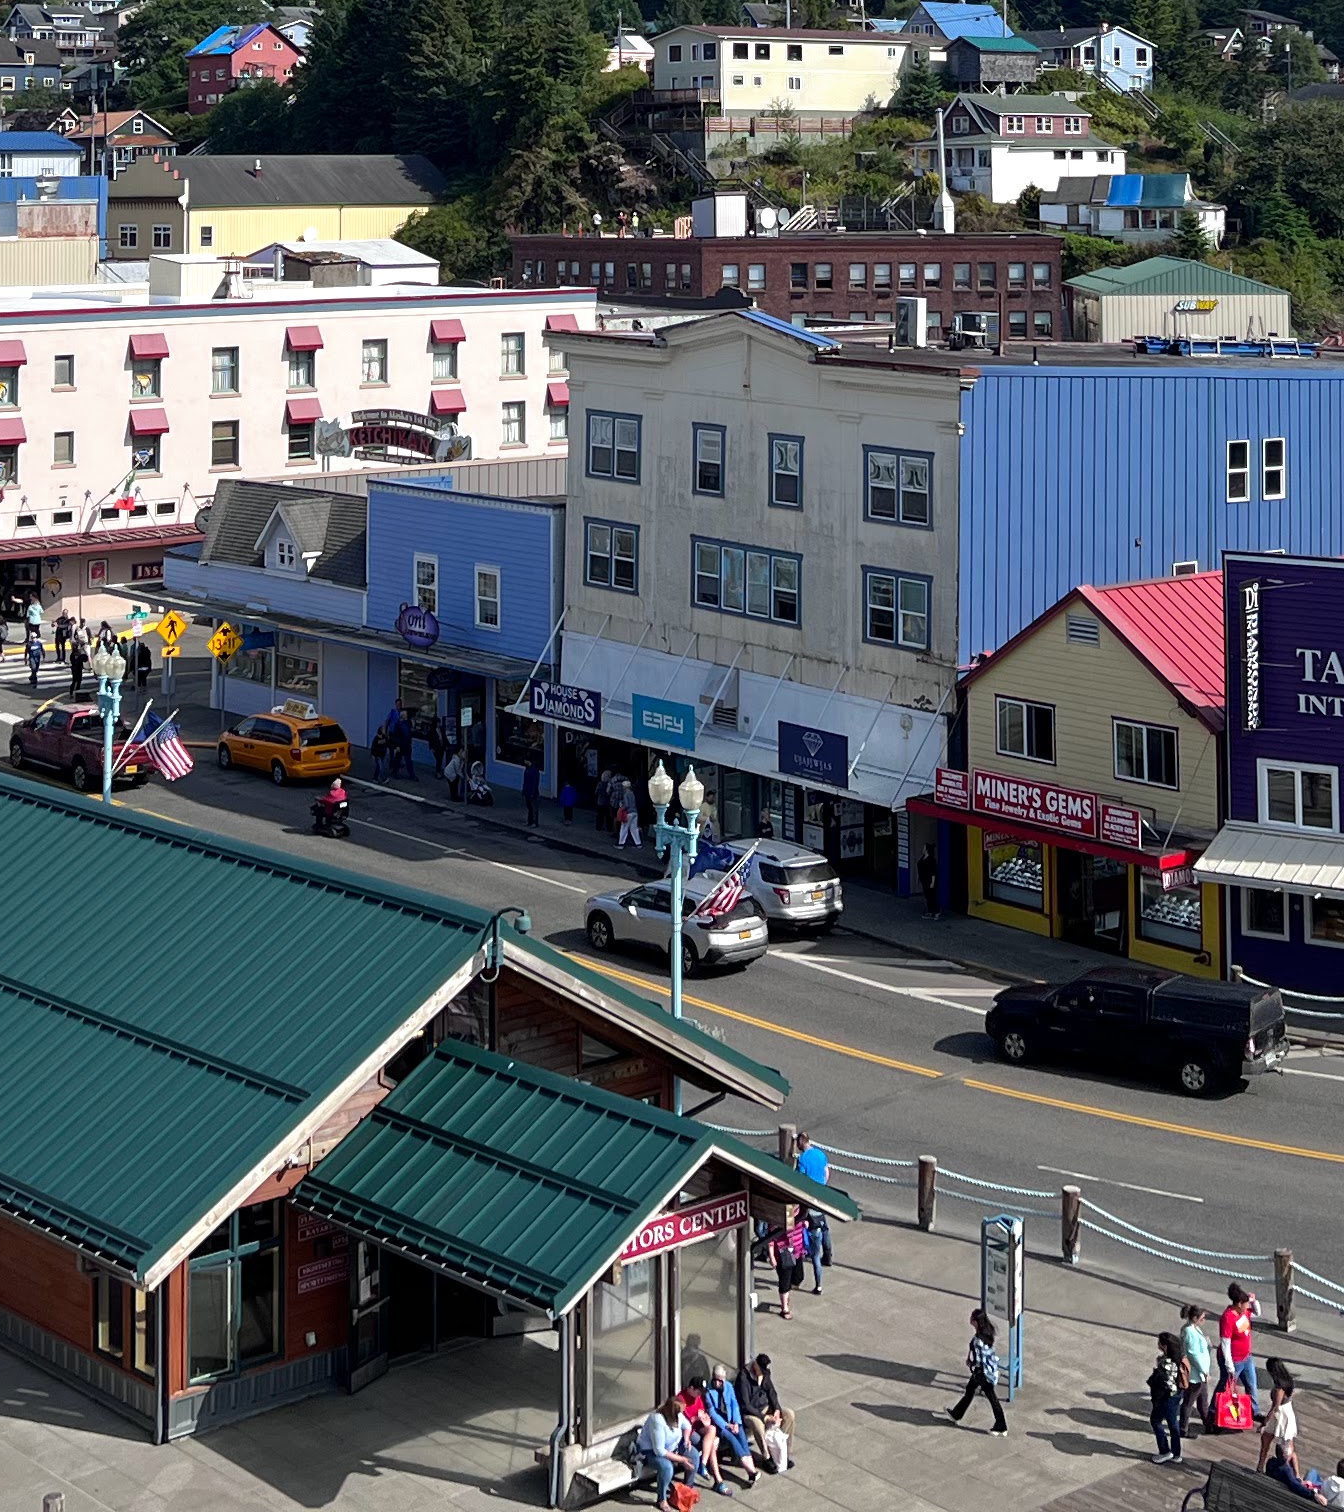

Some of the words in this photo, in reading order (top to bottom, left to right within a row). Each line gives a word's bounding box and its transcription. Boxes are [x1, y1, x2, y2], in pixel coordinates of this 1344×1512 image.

[1175, 299, 1219, 311] SUBWAY
[349, 427, 431, 455] KETCHIKAN
[534, 687, 595, 722] DIAMONDS
[550, 684, 578, 700] HOUSE
[977, 775, 1042, 809] MINER'S
[1045, 791, 1093, 820] GEMS
[984, 797, 1000, 811] Fine
[1001, 800, 1027, 818] Jewelry
[1028, 807, 1036, 818] &
[1037, 809, 1059, 824] Exotic
[1060, 814, 1083, 829] Gems
[680, 1199, 747, 1235] CENTER
